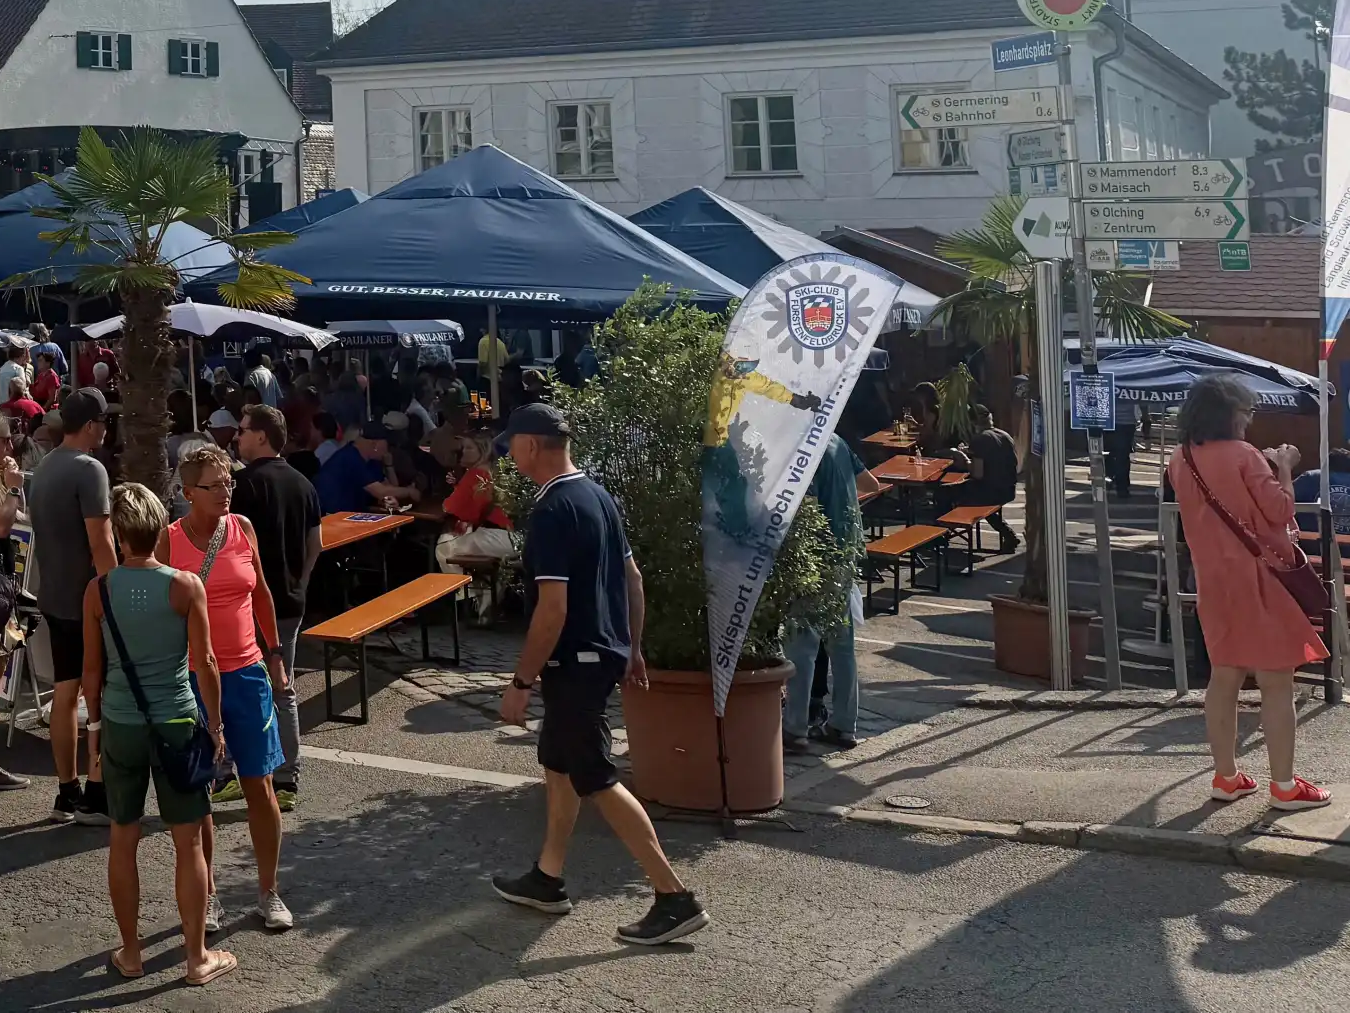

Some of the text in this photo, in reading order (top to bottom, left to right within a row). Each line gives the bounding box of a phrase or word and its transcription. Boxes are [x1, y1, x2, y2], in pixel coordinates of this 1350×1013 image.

[995, 41, 1053, 63] Leonhardsplatz
[943, 95, 1010, 108] Germering
[1030, 91, 1042, 103] 11
[945, 110, 998, 122] Bahnhof
[1035, 106, 1053, 117] 0.6
[1100, 165, 1177, 178] Mammendorf
[1191, 164, 1209, 176] 8.3
[1101, 182, 1151, 193] Maisach
[1193, 180, 1210, 192] 5.6
[1102, 206, 1144, 219] Olching
[1194, 207, 1211, 218] 6.9
[1104, 223, 1156, 234] Zentrum
[327, 285, 567, 303] GUT, BESSER, PAULANER.
[794, 286, 839, 298] SKI-CLUB
[790, 299, 845, 346] FÜRSTENFELDBRUCK
[340, 335, 393, 345] PAULANER
[413, 332, 455, 343] PAULANER
[716, 584, 753, 669] Skisport
[746, 538, 772, 584] und
[767, 488, 796, 538] noch
[788, 447, 812, 483] viel
